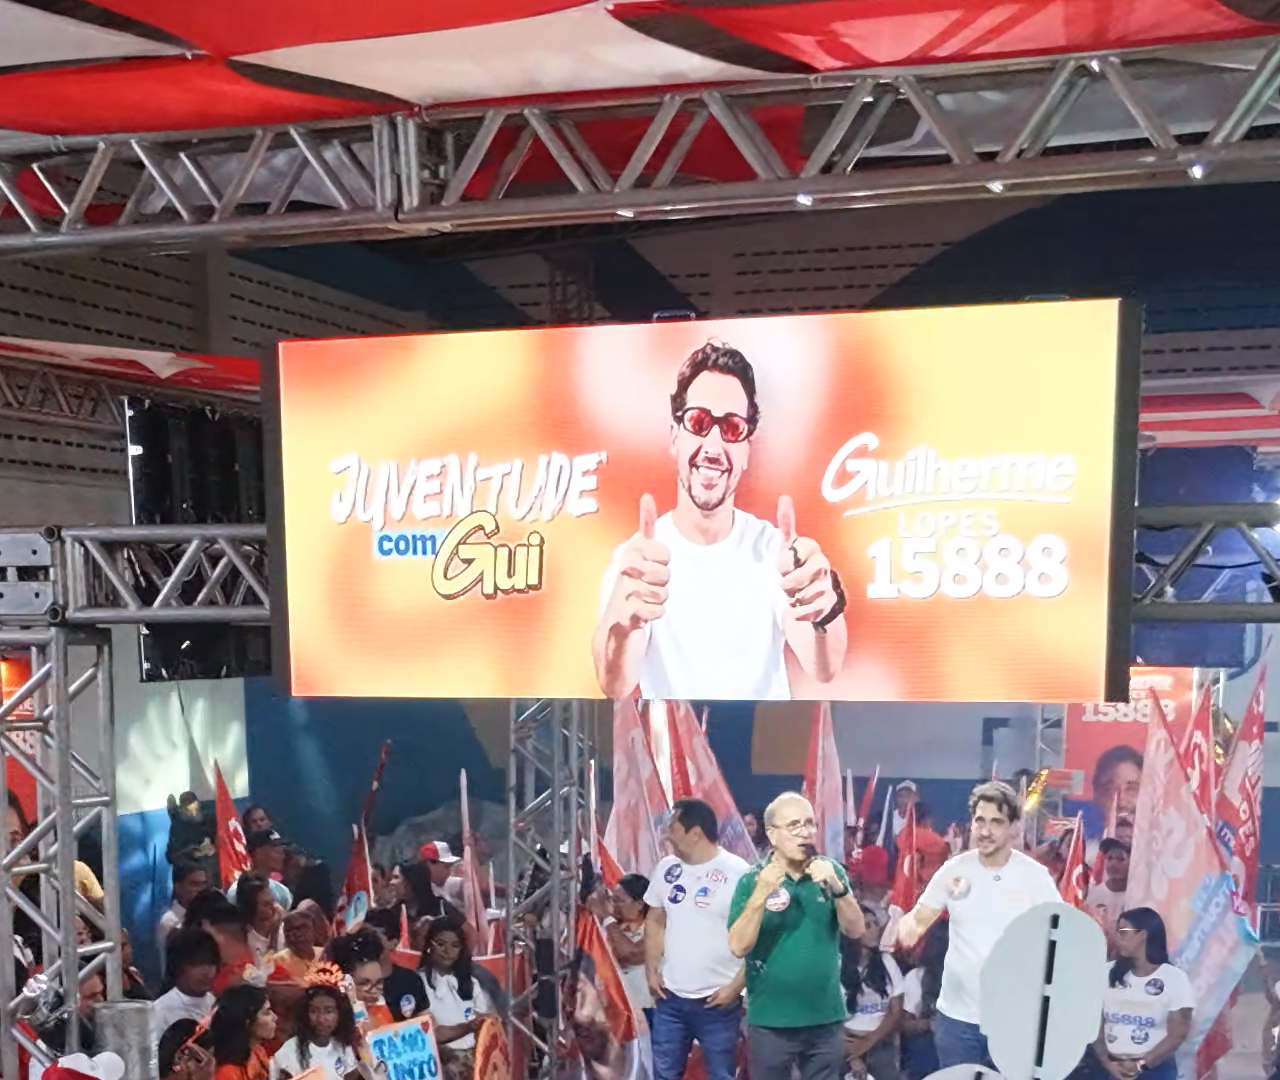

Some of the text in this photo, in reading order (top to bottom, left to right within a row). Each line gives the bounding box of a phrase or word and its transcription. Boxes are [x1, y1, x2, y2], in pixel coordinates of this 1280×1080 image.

[328, 451, 608, 531] JUVENTUDE
[821, 431, 1078, 502] Guilherme
[377, 509, 545, 600] com Gui
[897, 509, 1002, 538] LOPES
[866, 533, 1070, 600] 15888
